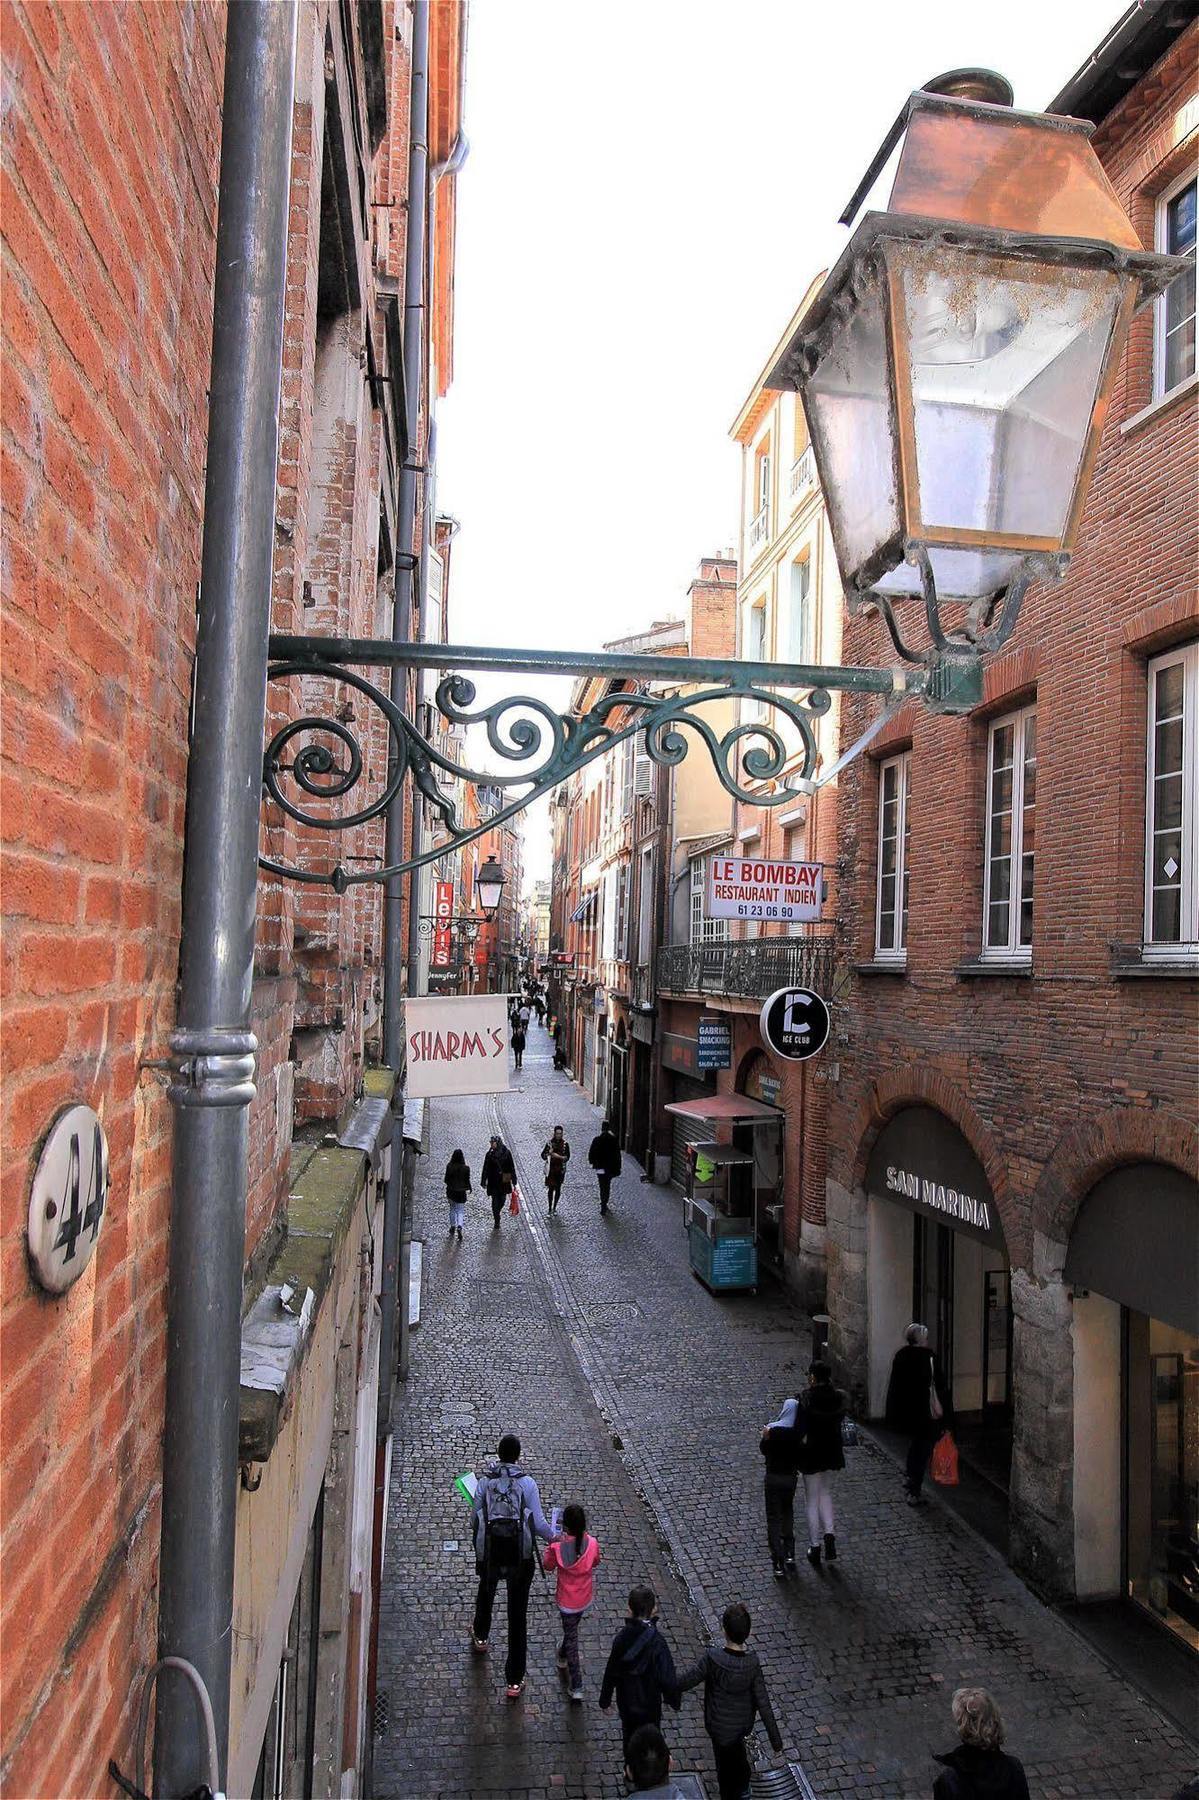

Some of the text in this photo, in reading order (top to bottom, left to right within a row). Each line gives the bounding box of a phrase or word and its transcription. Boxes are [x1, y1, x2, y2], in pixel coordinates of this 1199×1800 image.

[713, 861, 820, 888] LE BOMBAY
[715, 885, 817, 905] RESTAURANT INDIEN
[738, 904, 793, 918] 61 23 06 90
[428, 971, 457, 981] Jennyfer
[699, 1027, 730, 1035] GABRIEL
[410, 1027, 505, 1062] SHARM'S
[699, 1036, 730, 1045] SNACKING
[782, 1035, 810, 1045] ICE CLUB
[52, 1122, 104, 1265] 44
[886, 1166, 990, 1231] SAN MARINA
